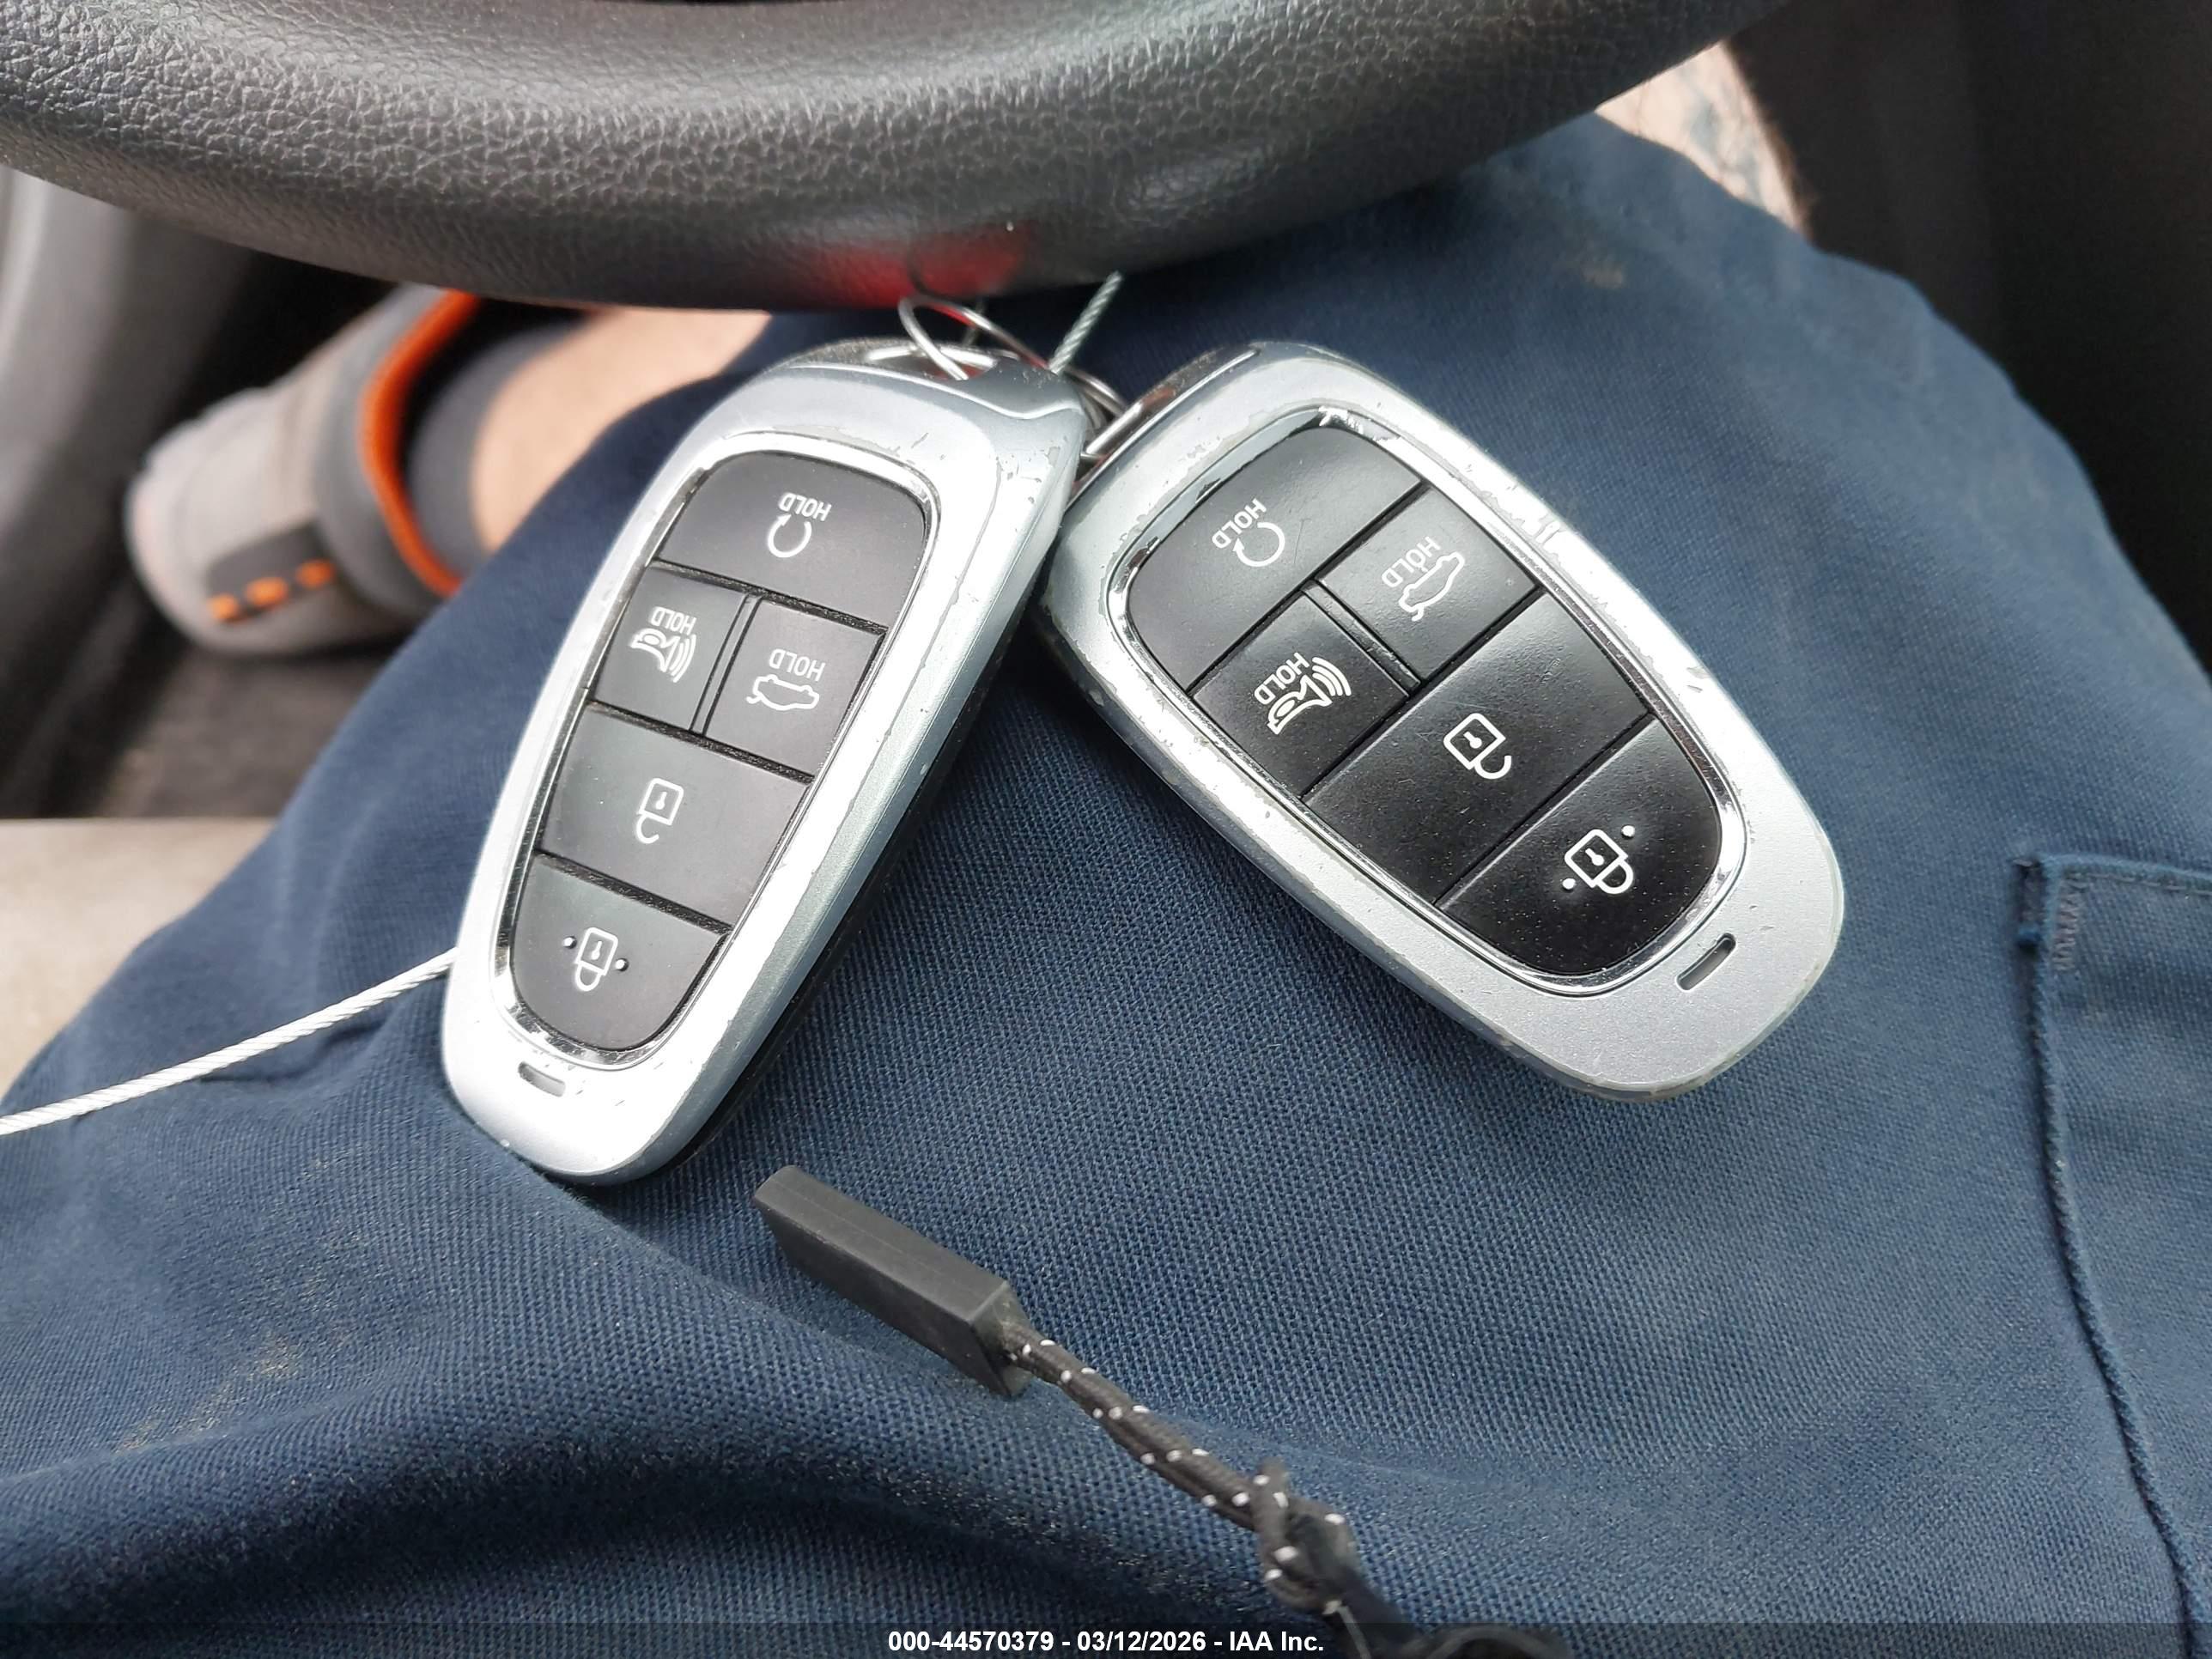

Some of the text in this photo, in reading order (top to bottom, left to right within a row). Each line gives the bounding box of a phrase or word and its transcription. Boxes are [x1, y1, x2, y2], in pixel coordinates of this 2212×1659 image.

[778, 492, 830, 521] HOLD
[1211, 497, 1267, 549] HOLD
[1381, 536, 1440, 587] HOLD
[650, 606, 697, 635] HOLD
[769, 647, 826, 682] HOLD
[1254, 652, 1310, 705] HOLD
